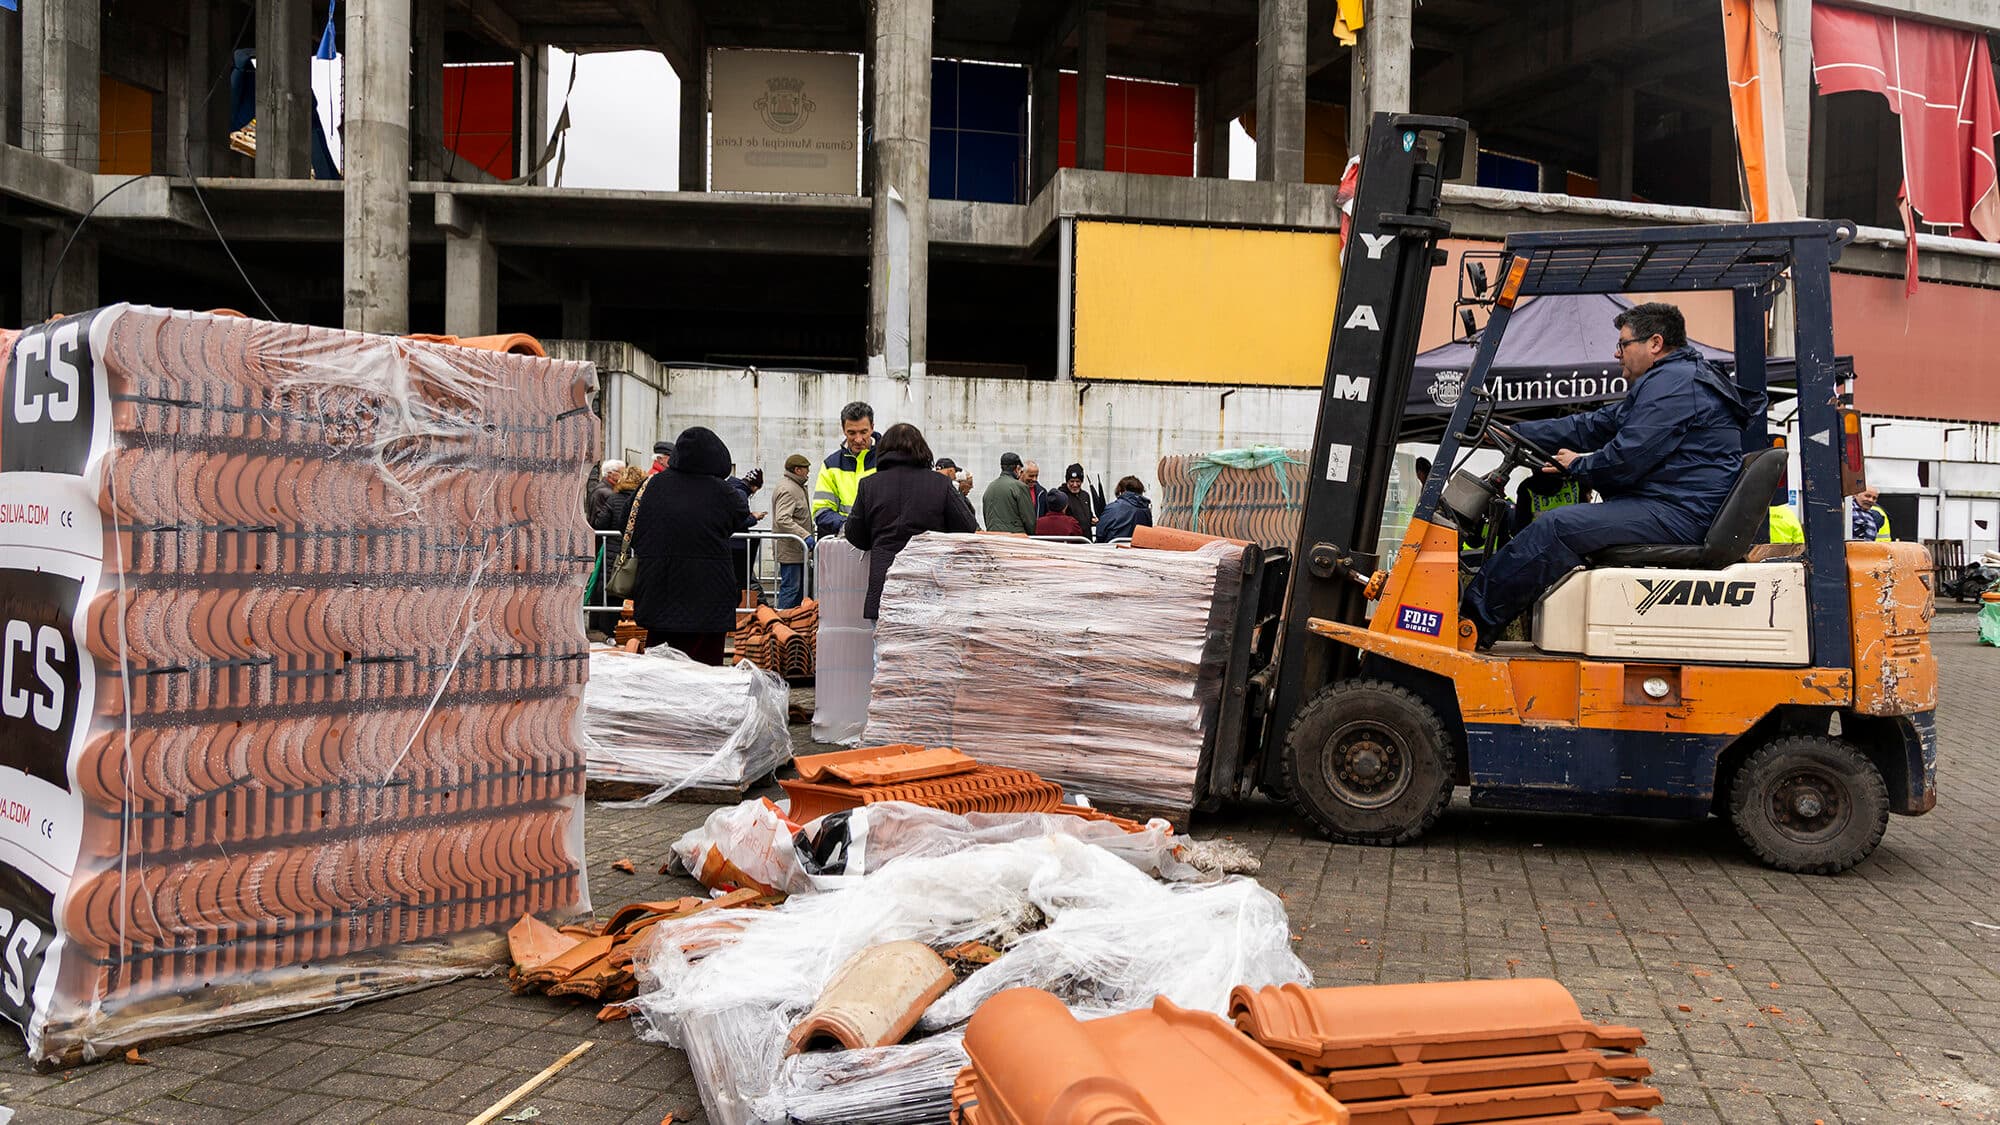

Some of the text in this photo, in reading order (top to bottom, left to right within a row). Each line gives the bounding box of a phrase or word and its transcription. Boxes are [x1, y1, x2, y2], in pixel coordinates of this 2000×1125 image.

[14, 321, 80, 423] CS
[1476, 369, 1629, 402] Município
[1635, 578, 1757, 616] YANG
[1403, 609, 1438, 627] FD15
[1405, 623, 1431, 633] DIESEL
[2, 619, 66, 732] CS
